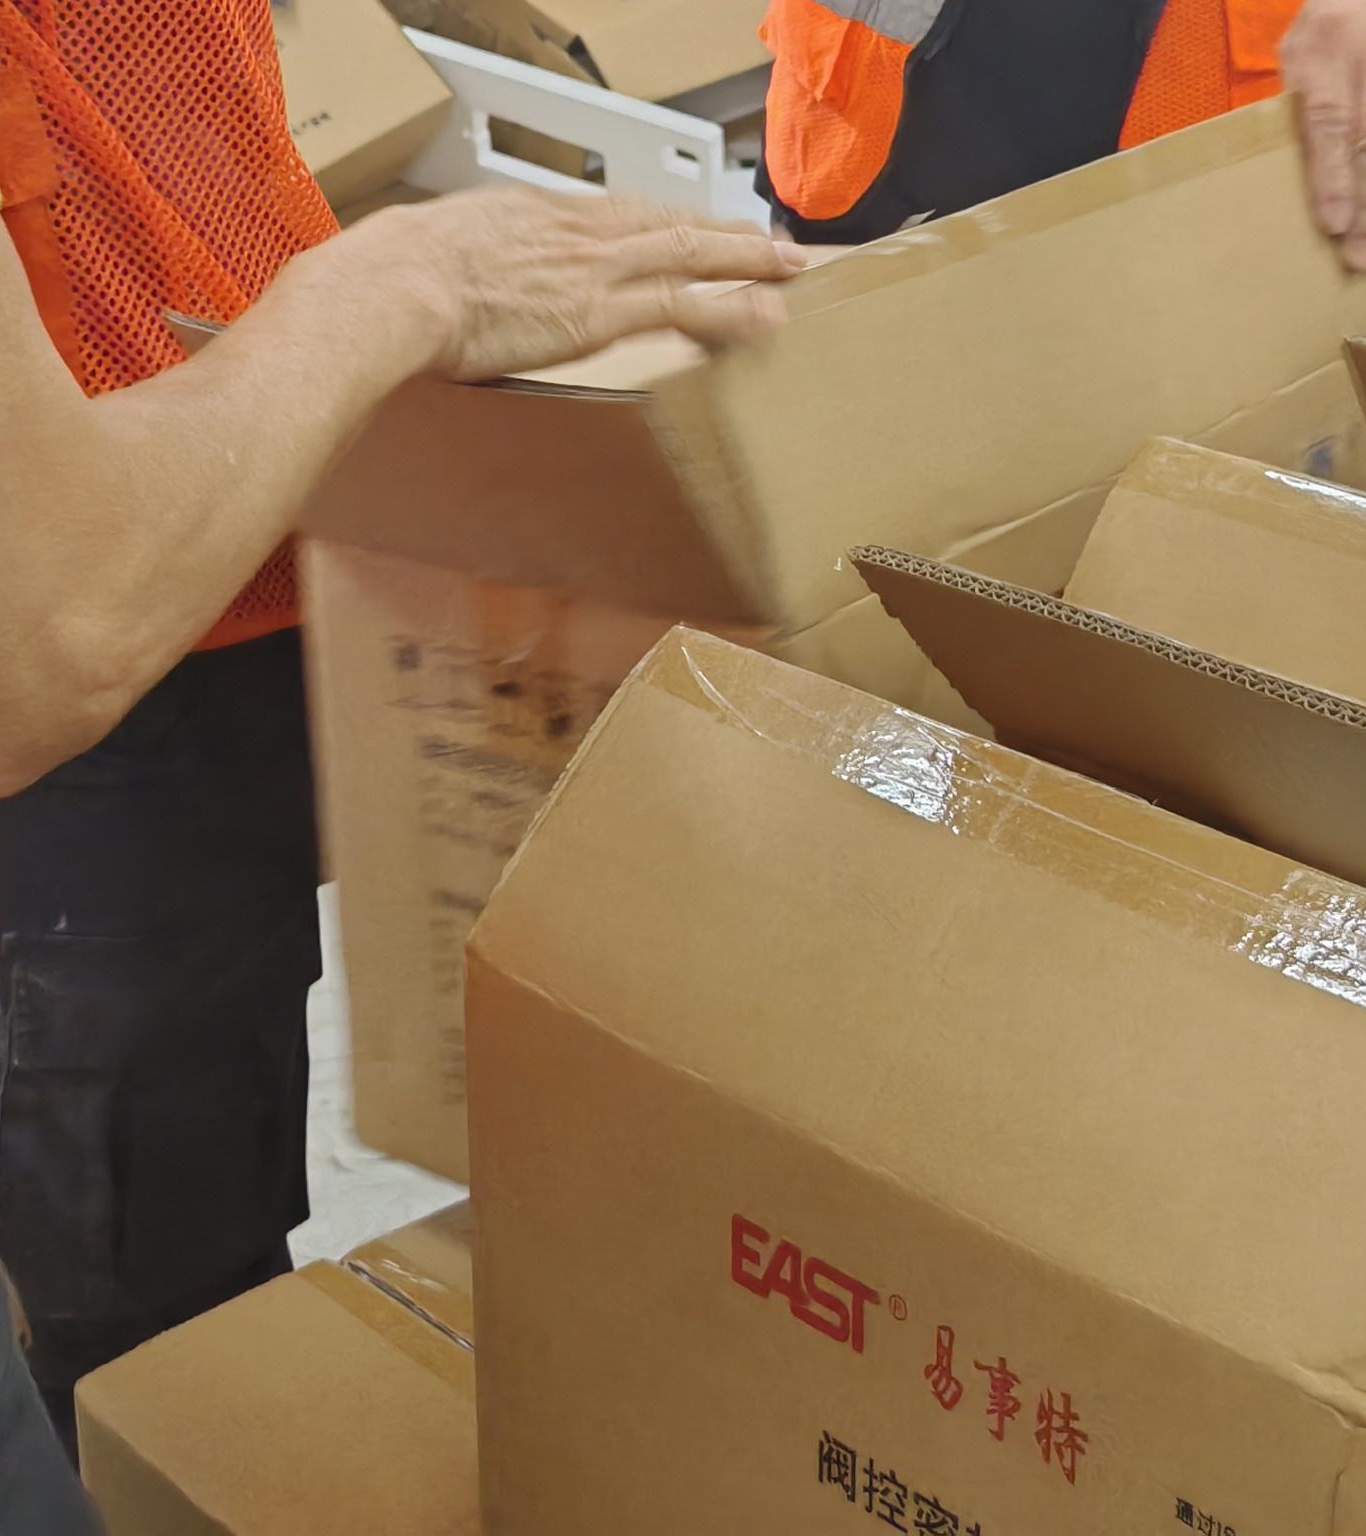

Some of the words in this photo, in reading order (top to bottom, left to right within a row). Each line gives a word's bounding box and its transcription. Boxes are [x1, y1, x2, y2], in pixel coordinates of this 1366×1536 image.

[731, 1213, 881, 1355] EAST
[923, 1325, 1089, 1487] 易事特
